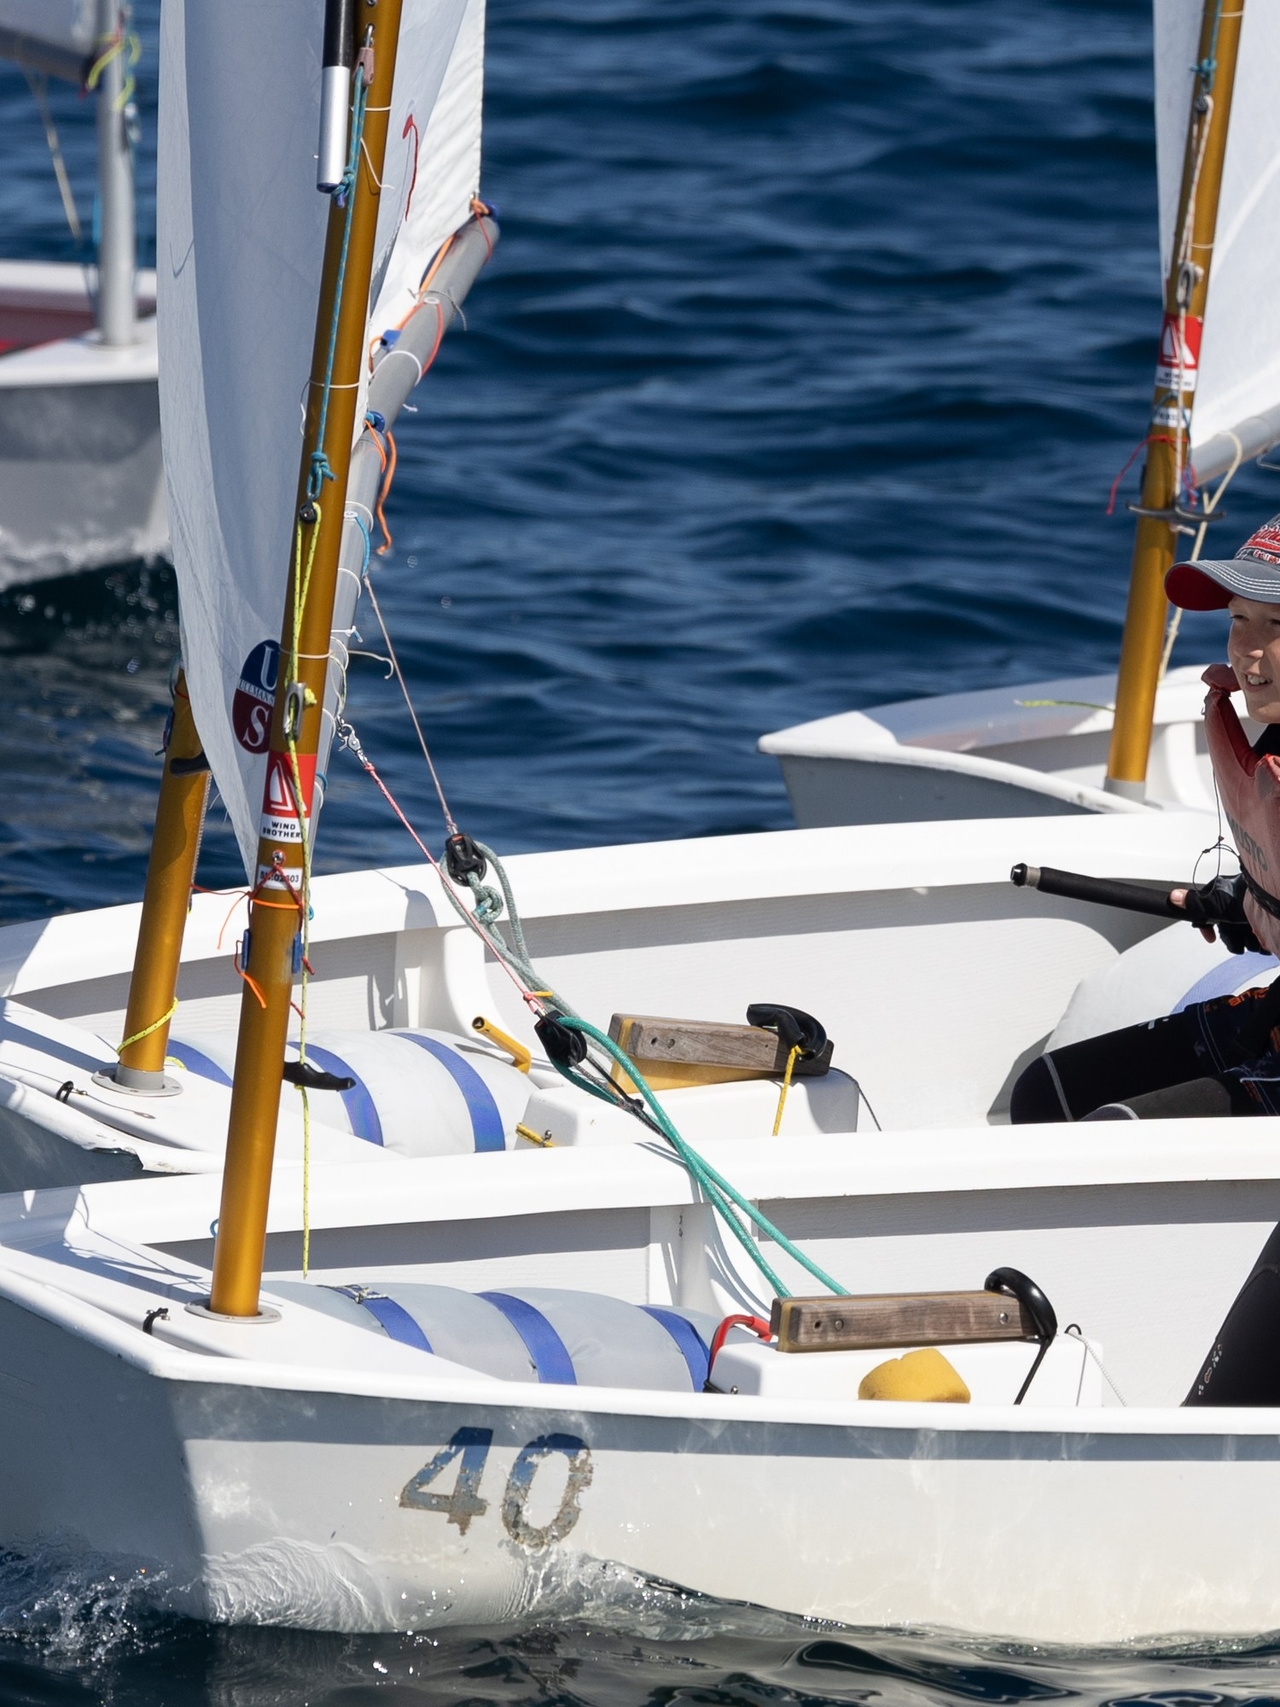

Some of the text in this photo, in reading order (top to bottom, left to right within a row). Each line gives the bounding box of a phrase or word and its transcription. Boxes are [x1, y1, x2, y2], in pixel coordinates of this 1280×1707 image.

[242, 705, 270, 747] S
[263, 827, 302, 838] BROTHER
[271, 821, 296, 830] WIND
[399, 1426, 593, 1549] 40
